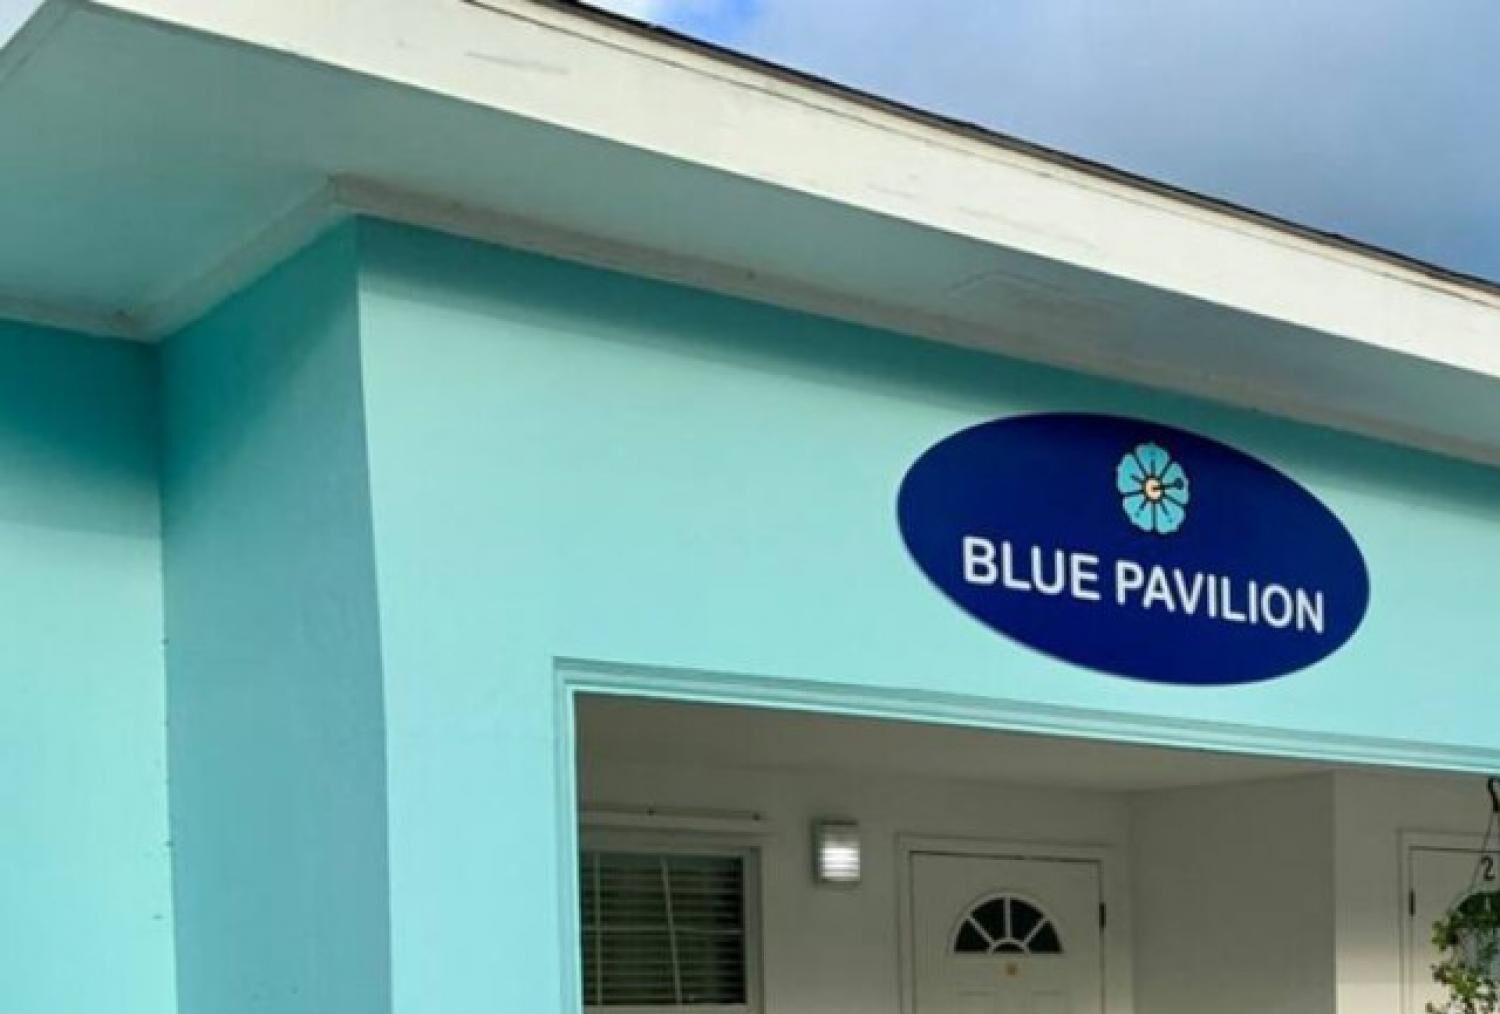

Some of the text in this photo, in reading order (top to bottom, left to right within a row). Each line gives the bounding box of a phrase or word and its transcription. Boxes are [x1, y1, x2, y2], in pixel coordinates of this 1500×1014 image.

[963, 536, 1325, 634] BLUE PAVILION
[1480, 856, 1496, 881] 2
